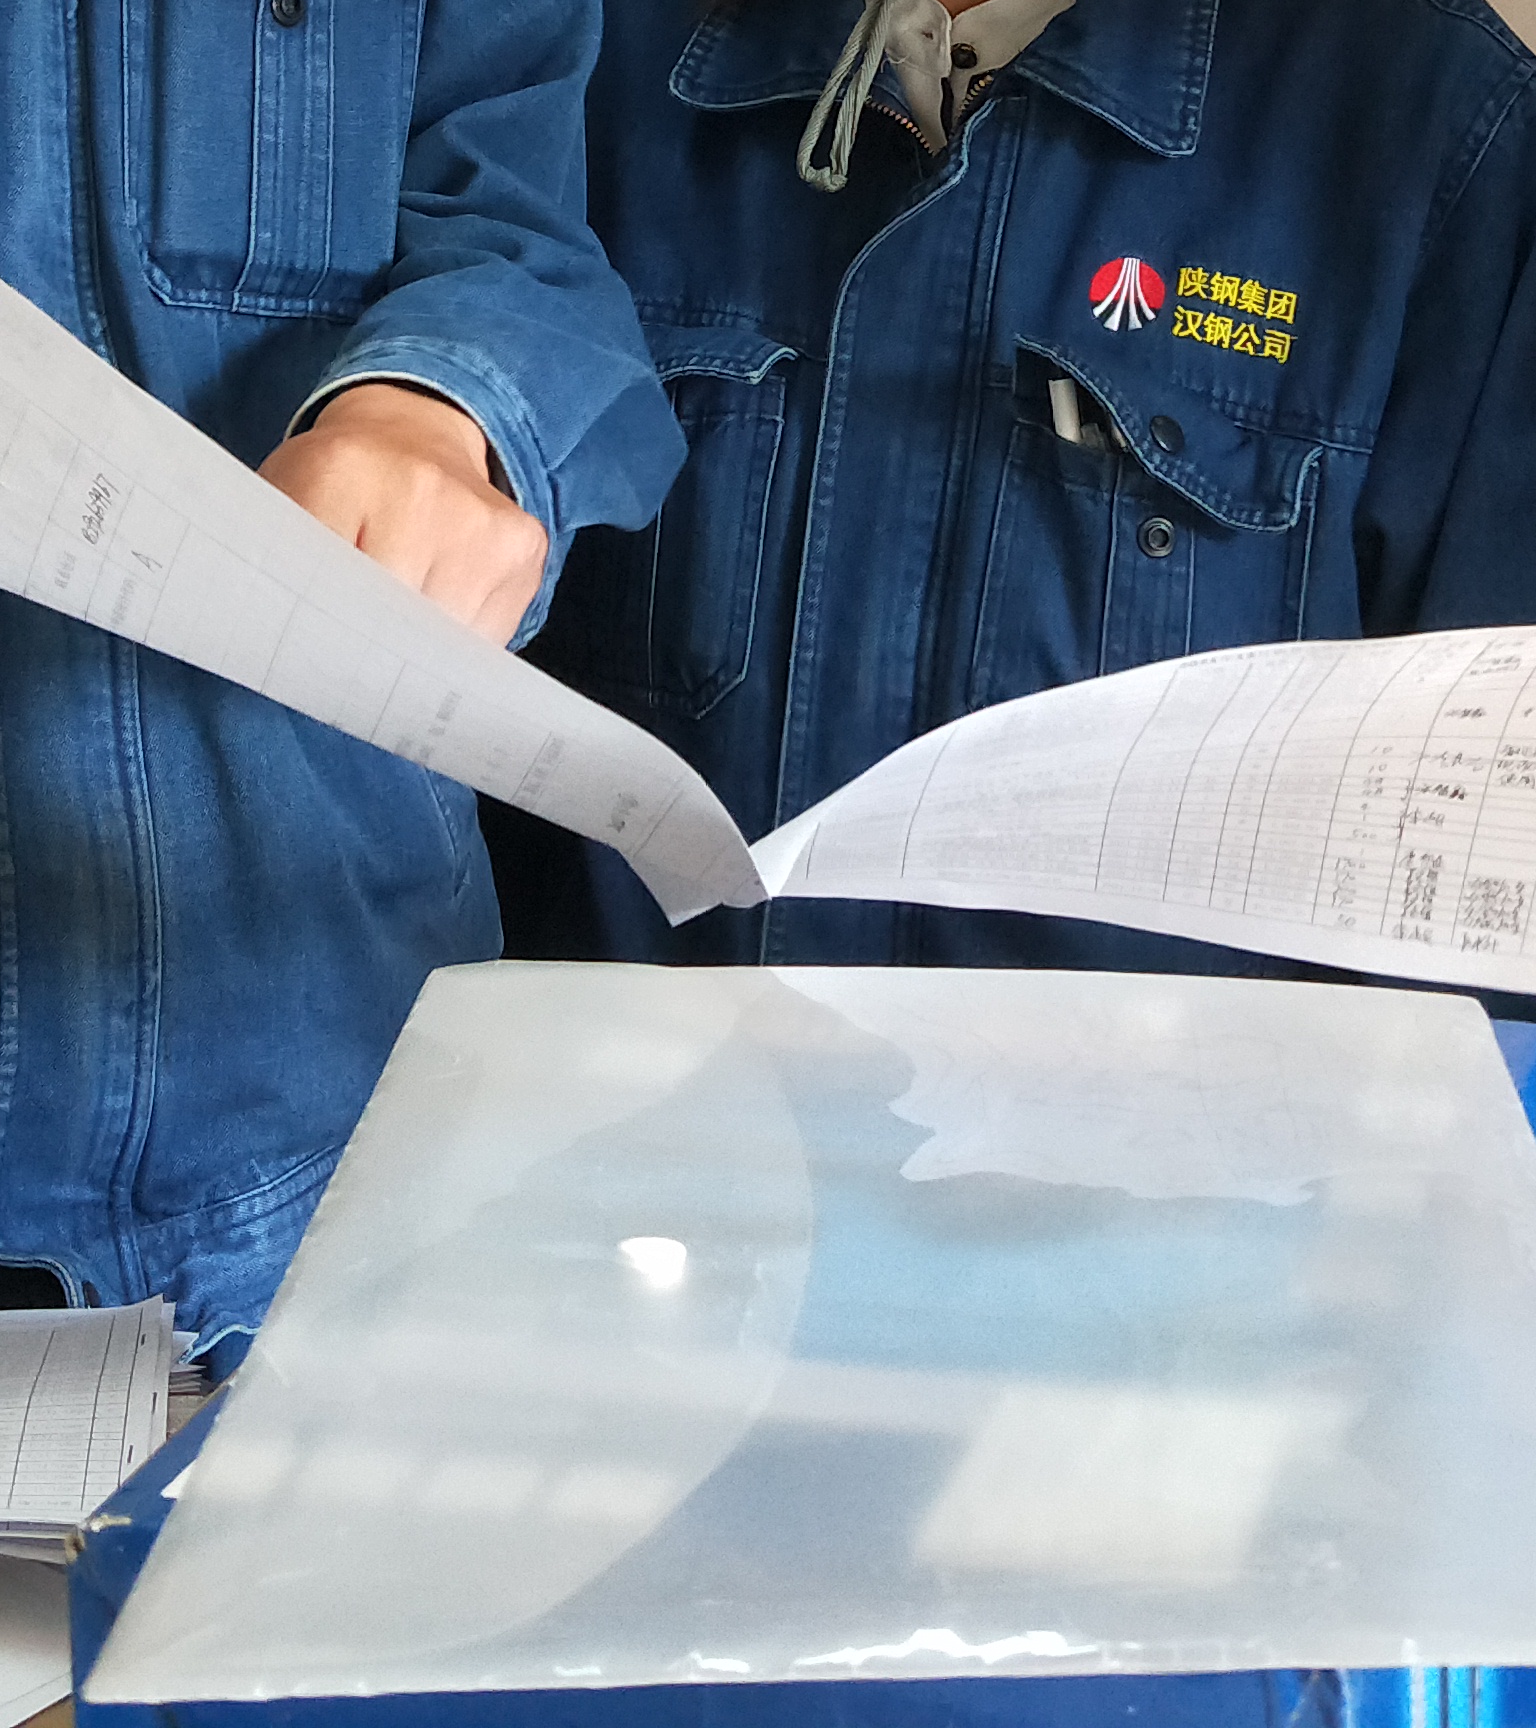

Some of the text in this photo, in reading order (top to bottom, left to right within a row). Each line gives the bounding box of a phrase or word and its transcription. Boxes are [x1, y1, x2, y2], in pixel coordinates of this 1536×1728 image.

[1176, 266, 1298, 325] 陕钢集团
[1171, 305, 1293, 364] 汉钢公司
